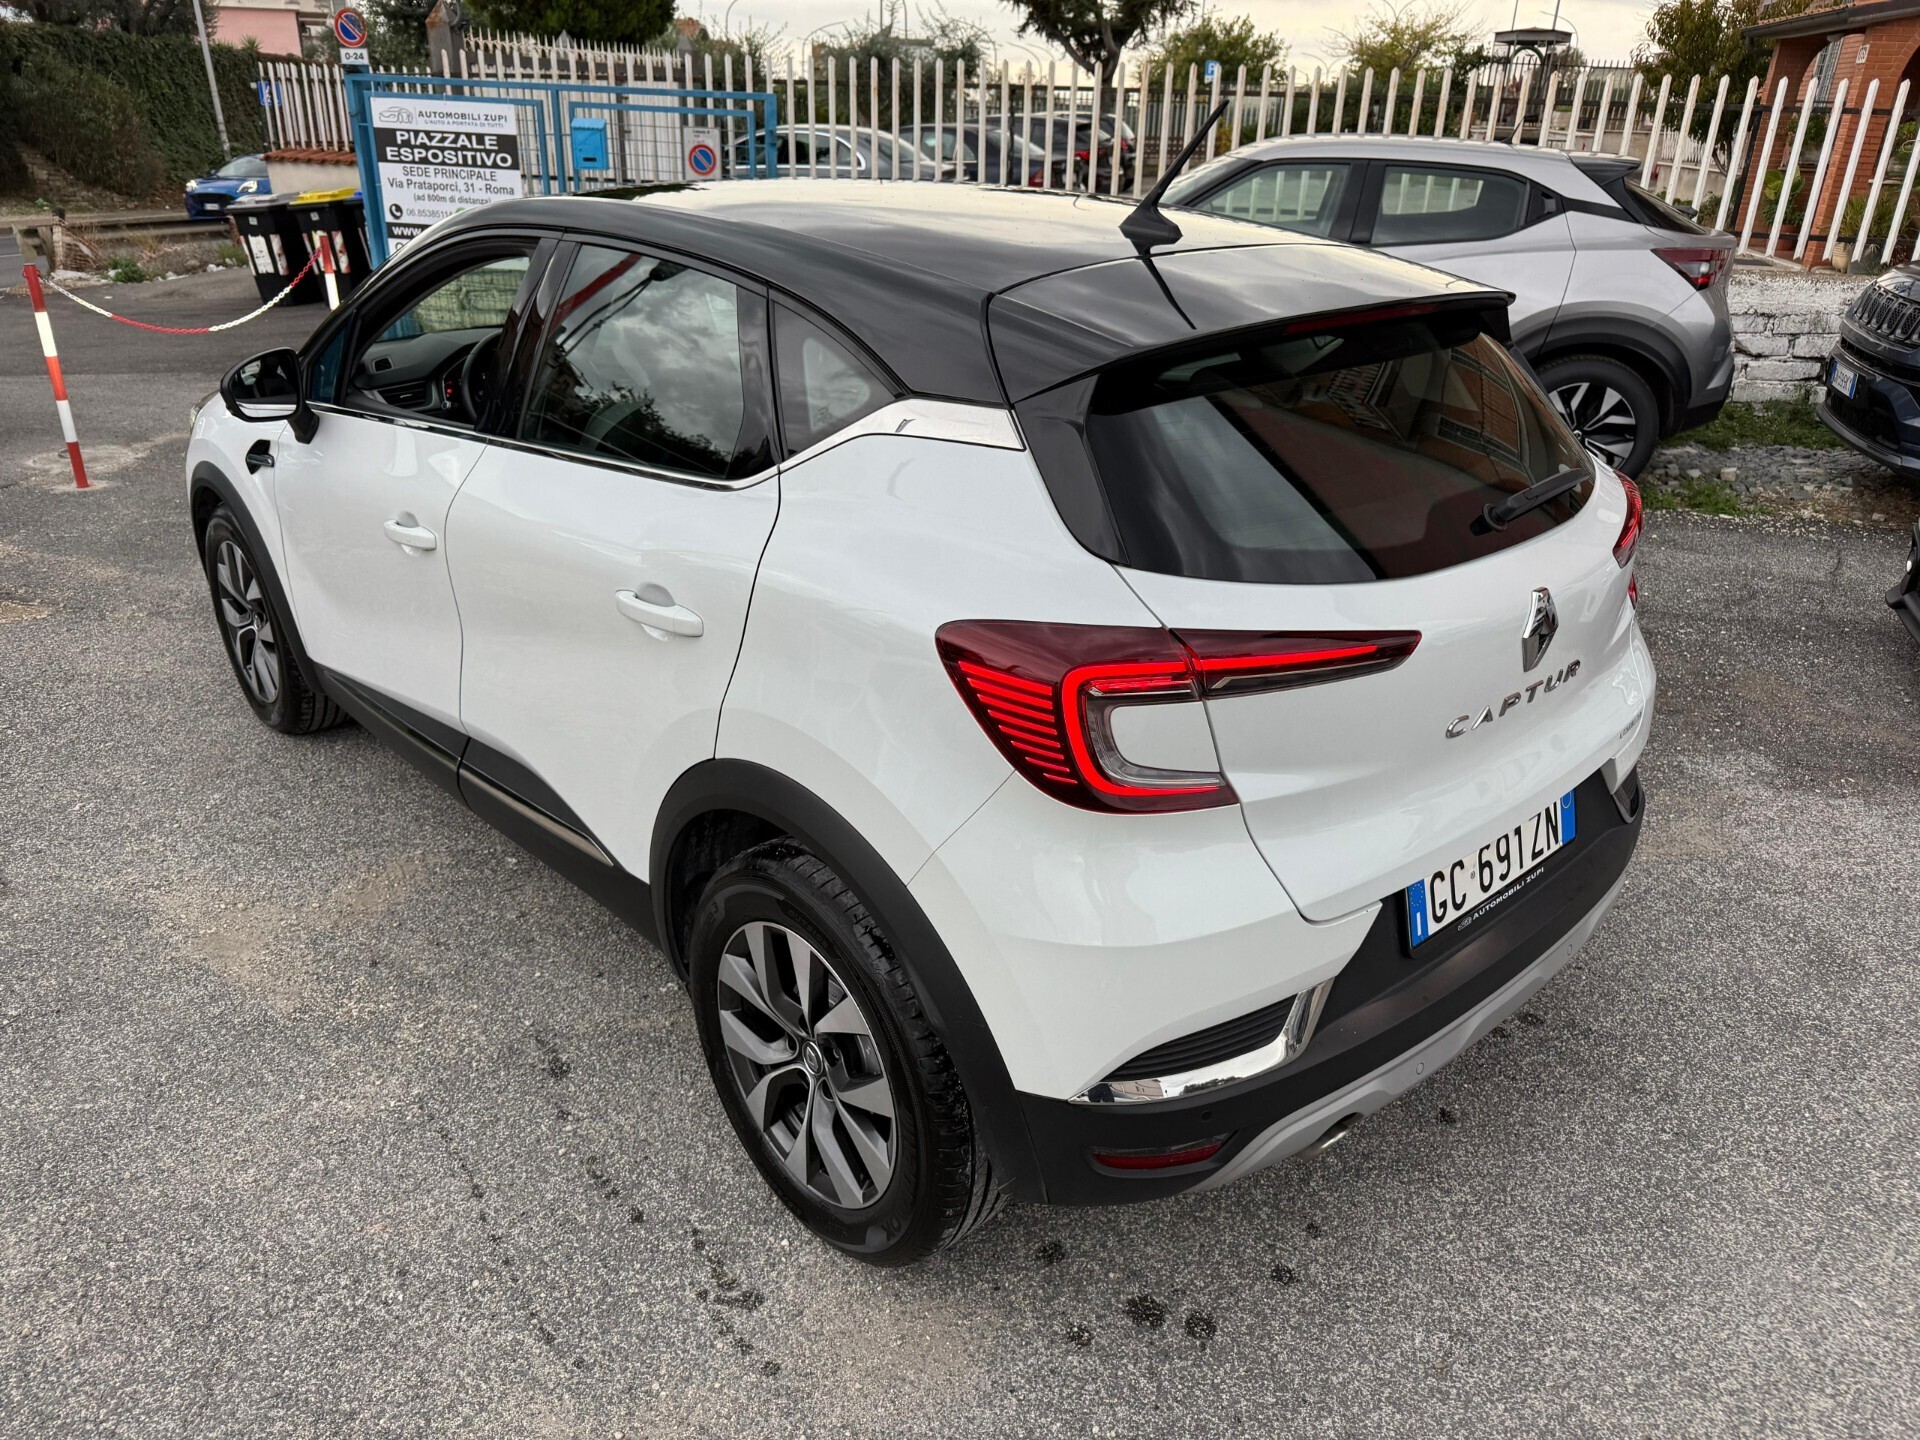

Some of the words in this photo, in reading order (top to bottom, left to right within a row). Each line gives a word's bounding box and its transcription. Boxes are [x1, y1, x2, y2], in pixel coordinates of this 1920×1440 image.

[345, 52, 364, 60] 0-24
[418, 110, 481, 121] AUTOMOBILI
[484, 114, 508, 122] ZUPI
[396, 130, 499, 150] PIAZZALE
[386, 147, 512, 168] ESPOSITIVO
[402, 165, 431, 178] SEDE
[433, 168, 497, 182] PRINCIPALE
[387, 177, 404, 189] Via
[406, 179, 461, 193] Prataporci,
[464, 182, 475, 193] 31
[485, 184, 515, 195] Roma
[413, 193, 426, 203] (ad
[427, 193, 448, 203] 800m
[449, 195, 457, 203] di
[1445, 659, 1581, 739] CAPTUR
[1472, 880, 1525, 921] AUTOMOBILI
[1525, 866, 1545, 884] ZUPI
